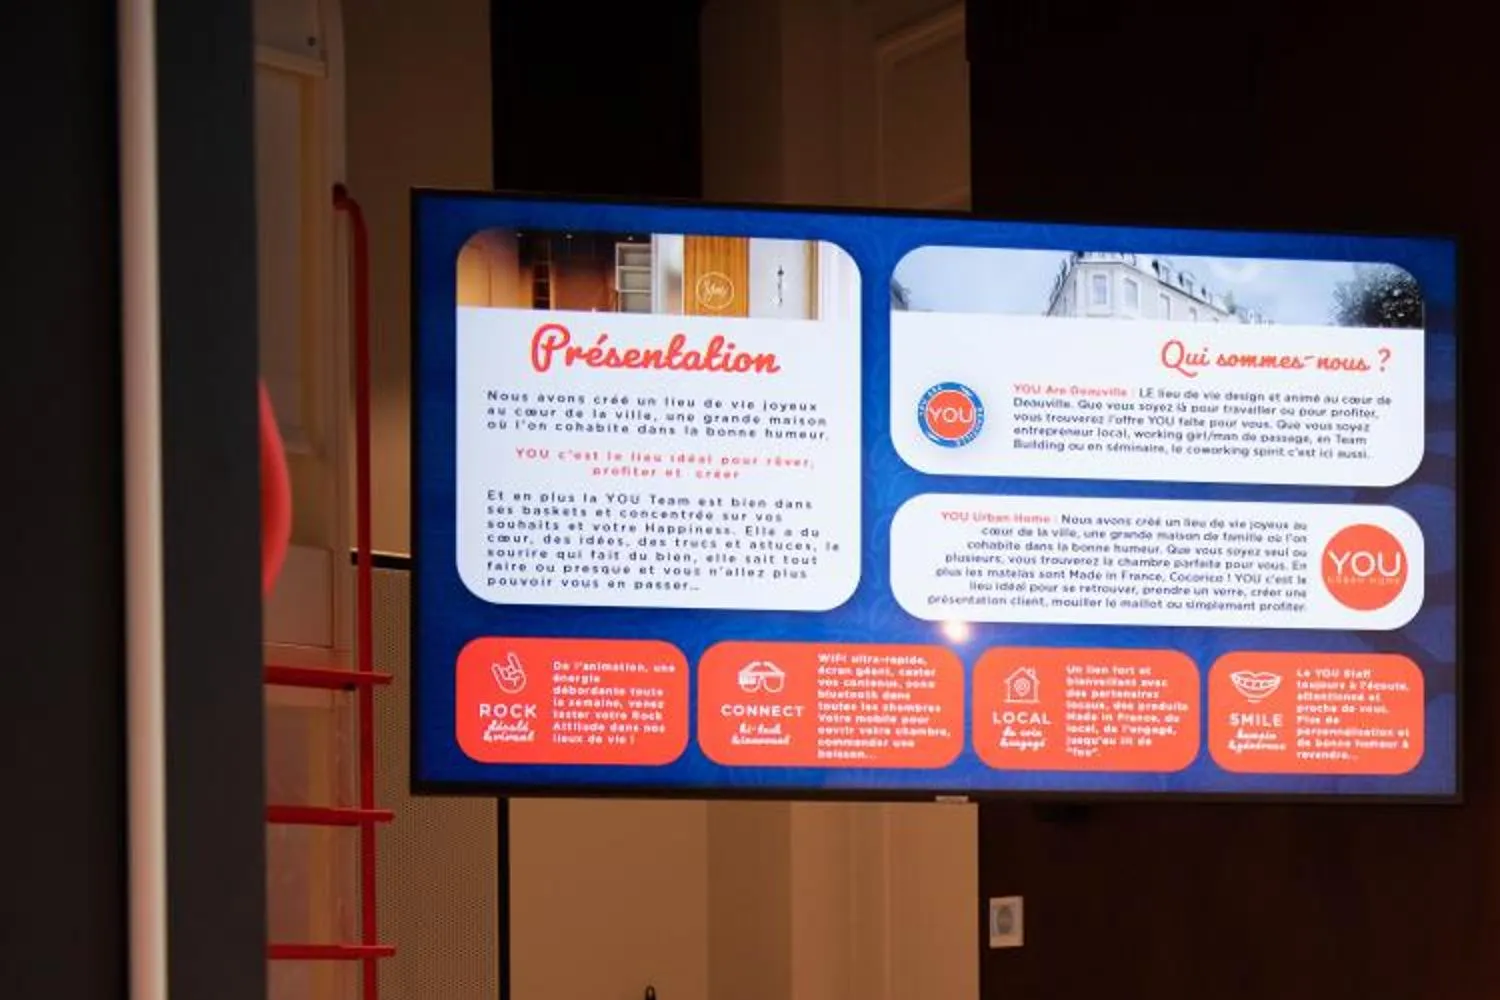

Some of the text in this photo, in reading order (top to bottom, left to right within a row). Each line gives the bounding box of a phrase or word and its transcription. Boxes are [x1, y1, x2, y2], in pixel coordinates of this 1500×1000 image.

[531, 324, 781, 374] Présentation
[1161, 339, 1210, 378] Qui
[1378, 348, 1391, 372] ?
[486, 390, 816, 413] Nous avons créé un lieu de vie joyeux
[487, 407, 506, 416] au
[514, 408, 556, 417] cœur
[564, 408, 584, 419] de
[592, 408, 607, 419] la
[666, 413, 695, 422] une
[703, 414, 760, 425] grande
[769, 416, 826, 426] maison
[929, 406, 973, 423] YOU
[486, 420, 507, 430] où
[555, 422, 629, 433] cohabite
[637, 424, 676, 435] dans
[684, 425, 698, 436] la
[706, 426, 756, 438] bonne
[487, 489, 811, 509] Et en plus la YOU Team est bien dans
[487, 506, 782, 522] ses baskets et concentrée sur vos
[487, 520, 559, 531] souhaits
[568, 521, 583, 531] et
[592, 522, 637, 533] votre
[745, 525, 775, 536] Elle
[784, 529, 792, 537] a
[800, 527, 819, 537] du
[543, 534, 571, 545] des
[637, 536, 666, 547] des
[675, 538, 717, 549] trucs
[725, 539, 740, 549] et
[826, 542, 839, 551] le
[487, 549, 548, 559] sourire
[556, 551, 582, 561] qui
[590, 549, 619, 560] fait
[628, 551, 647, 561] du
[706, 553, 736, 564] elle
[745, 554, 774, 564] sait
[783, 555, 817, 565] tout
[1327, 550, 1401, 577] YOU
[487, 561, 527, 572] faire
[535, 564, 555, 573] ou
[563, 565, 631, 575] presque
[639, 565, 654, 575] et
[663, 567, 700, 576] vous
[773, 568, 806, 580] plus
[487, 577, 552, 587] pouvoir
[561, 579, 599, 588] vous
[607, 580, 625, 589] en
[479, 703, 537, 719] ROCK
[720, 704, 804, 717] CONNECT
[991, 711, 1052, 725] LOCAL
[1229, 712, 1283, 727] SMILE
